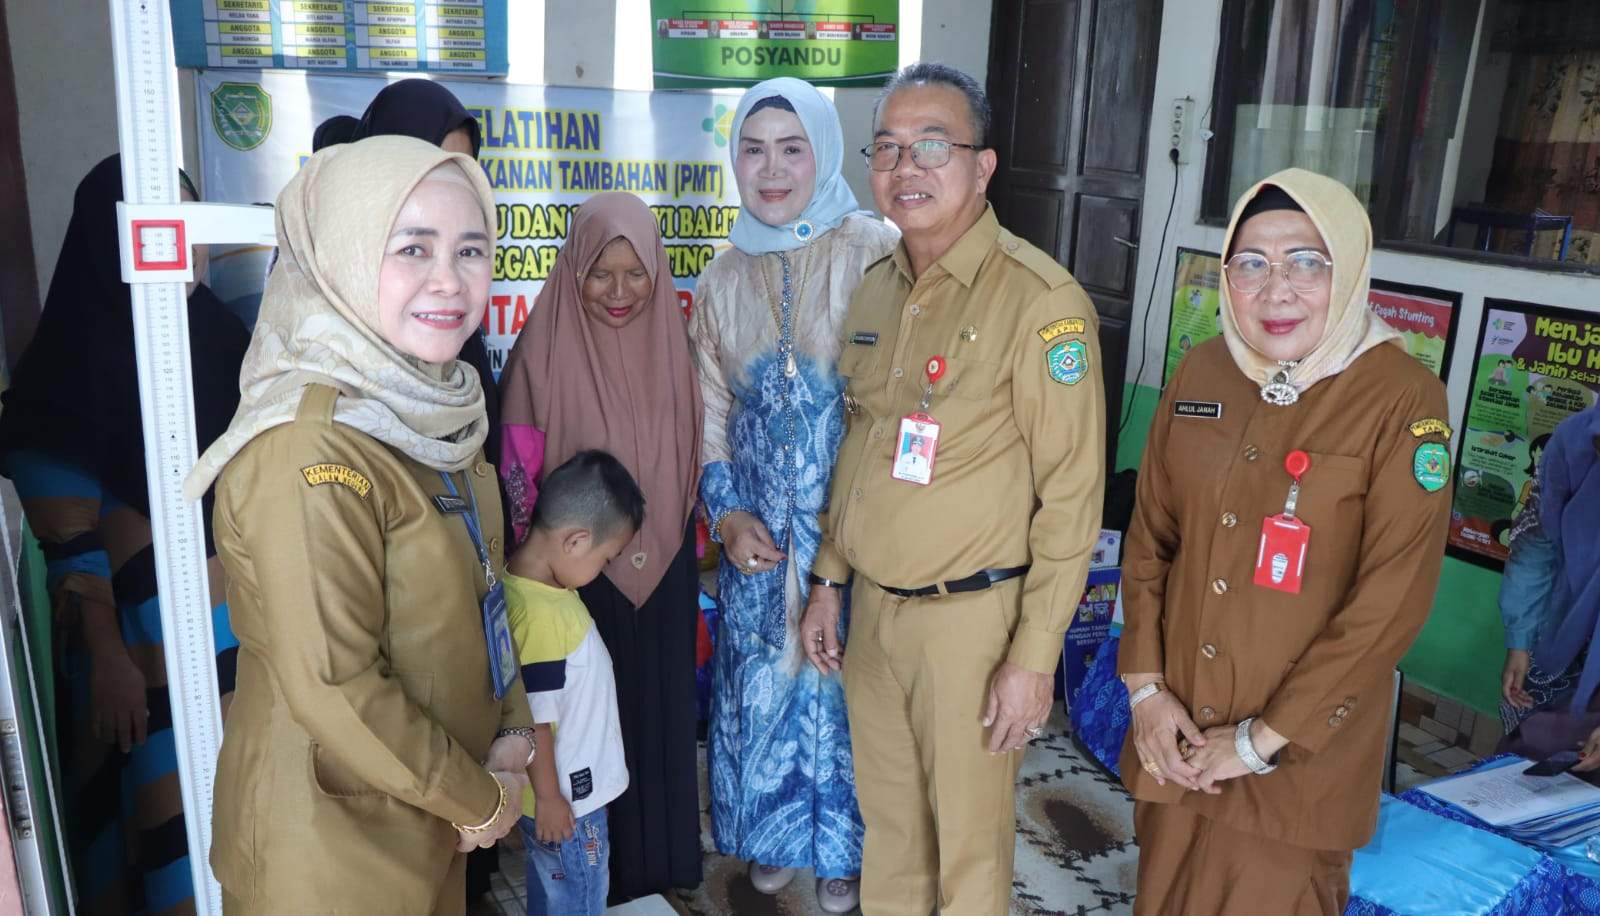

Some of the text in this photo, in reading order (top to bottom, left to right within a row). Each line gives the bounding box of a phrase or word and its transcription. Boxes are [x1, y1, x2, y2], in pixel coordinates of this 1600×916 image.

[224, 1, 263, 9] SEKRETARIS
[300, 3, 338, 11] SEKRETARIS
[443, 8, 479, 16] SEKRETARIS
[230, 24, 261, 32] ANGGOTA
[306, 25, 336, 33] ANGGOTA
[232, 47, 263, 55] ANGGOTA
[307, 48, 337, 56] ANGGOTA
[449, 51, 477, 59] ANGGOTA
[721, 46, 841, 66] POSYANDU
[558, 160, 668, 193] TAMBAHAN
[674, 163, 724, 198] (PMT)
[510, 203, 569, 240] DAN
[1398, 307, 1435, 328] Stunting
[1547, 341, 1583, 366] Ibu
[1516, 357, 1527, 371] &
[1528, 360, 1569, 379] Janin
